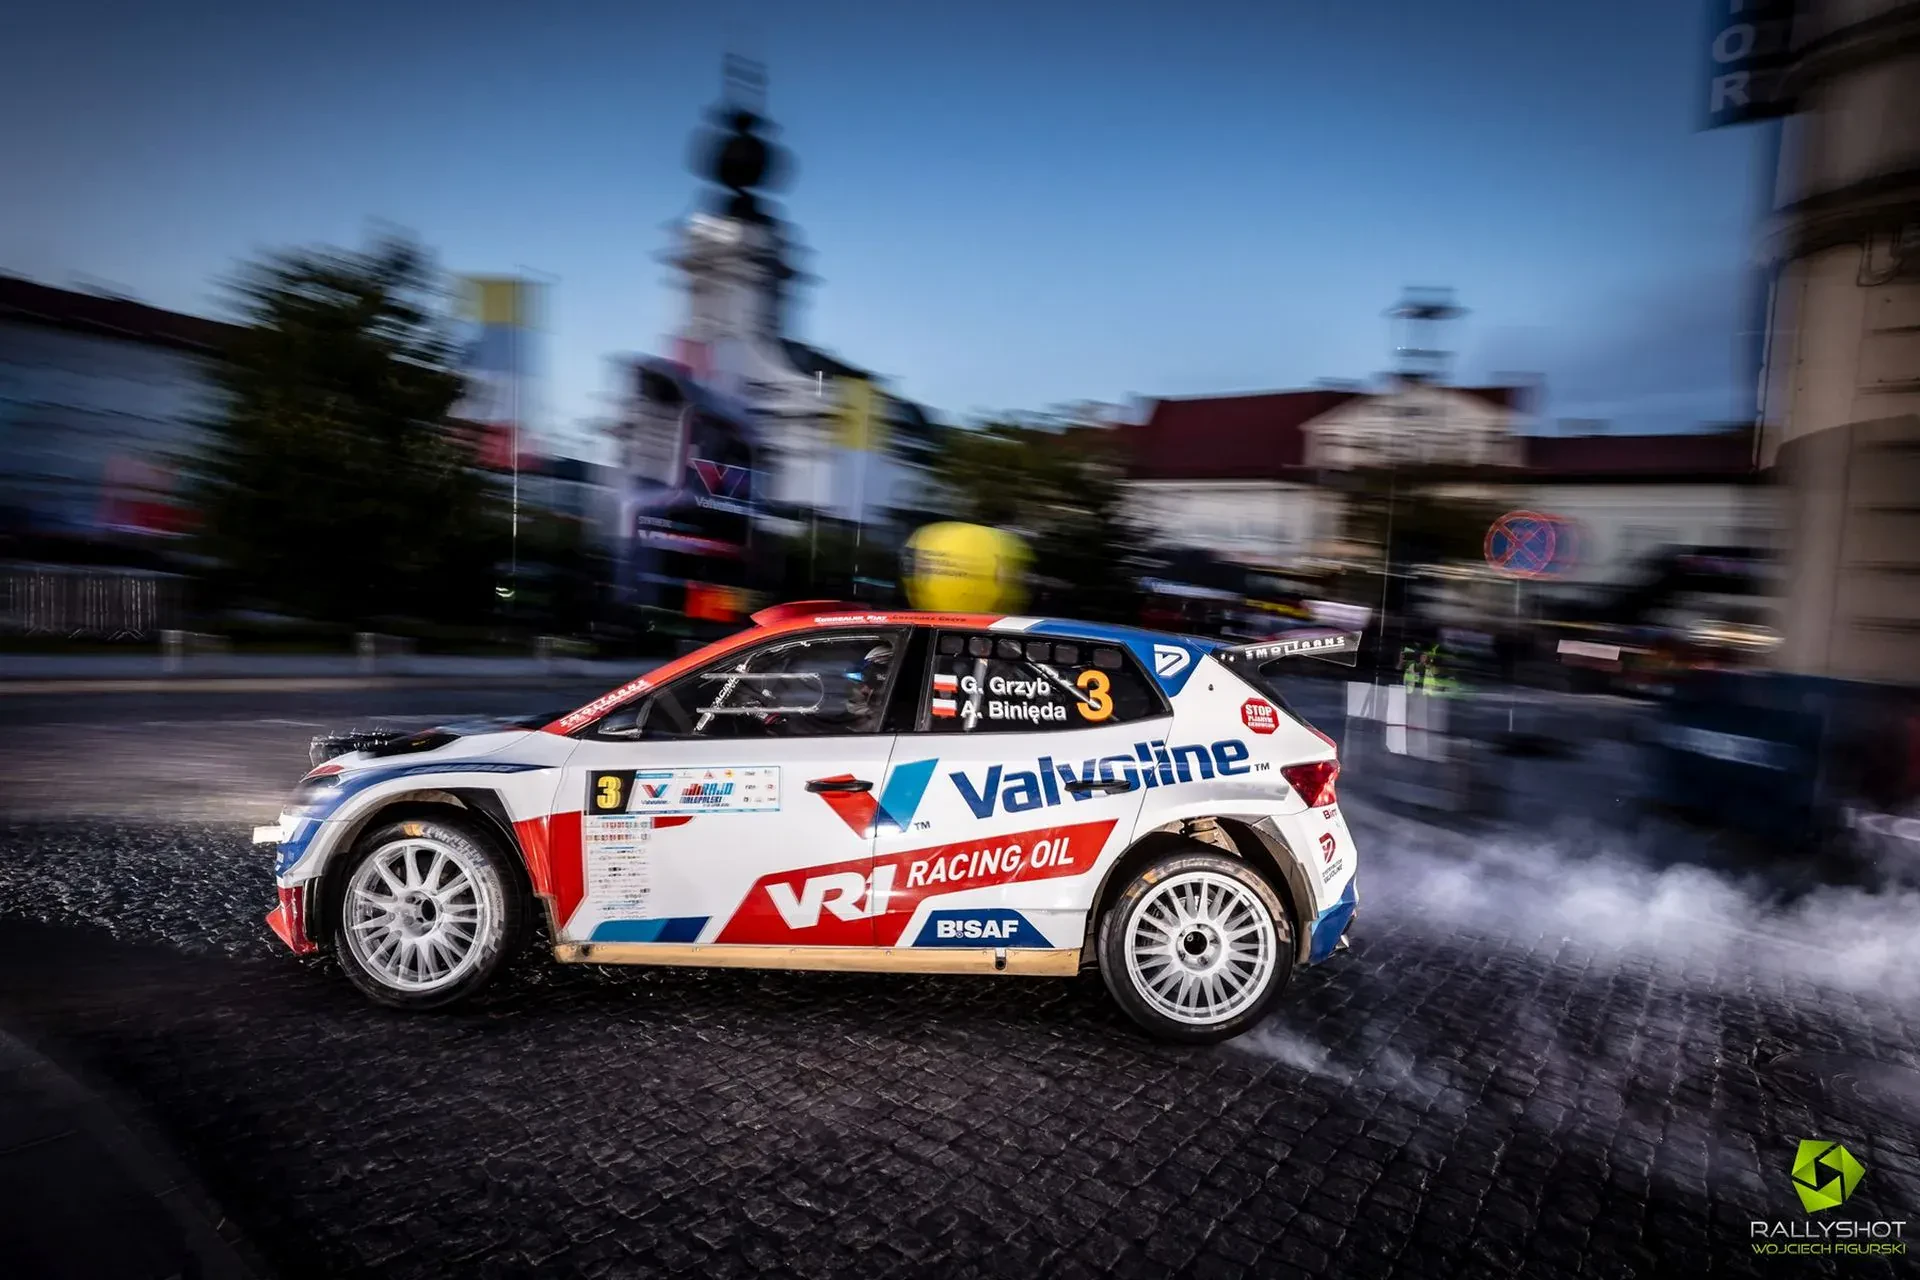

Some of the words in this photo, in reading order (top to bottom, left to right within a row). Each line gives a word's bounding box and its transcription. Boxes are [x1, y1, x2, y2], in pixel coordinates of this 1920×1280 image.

[1245, 636, 1345, 659] SMOLTRANS
[960, 676, 984, 695] G.
[989, 676, 1050, 699] Grzyb
[1077, 669, 1113, 724] 3
[960, 701, 983, 720] A.
[989, 701, 1067, 725] Binięda
[1245, 704, 1272, 716] STOP
[596, 776, 622, 809] 3
[948, 738, 1251, 820] Valvoline
[765, 864, 898, 930] VR1
[906, 845, 1024, 888] RACING
[1030, 836, 1075, 869] OIL
